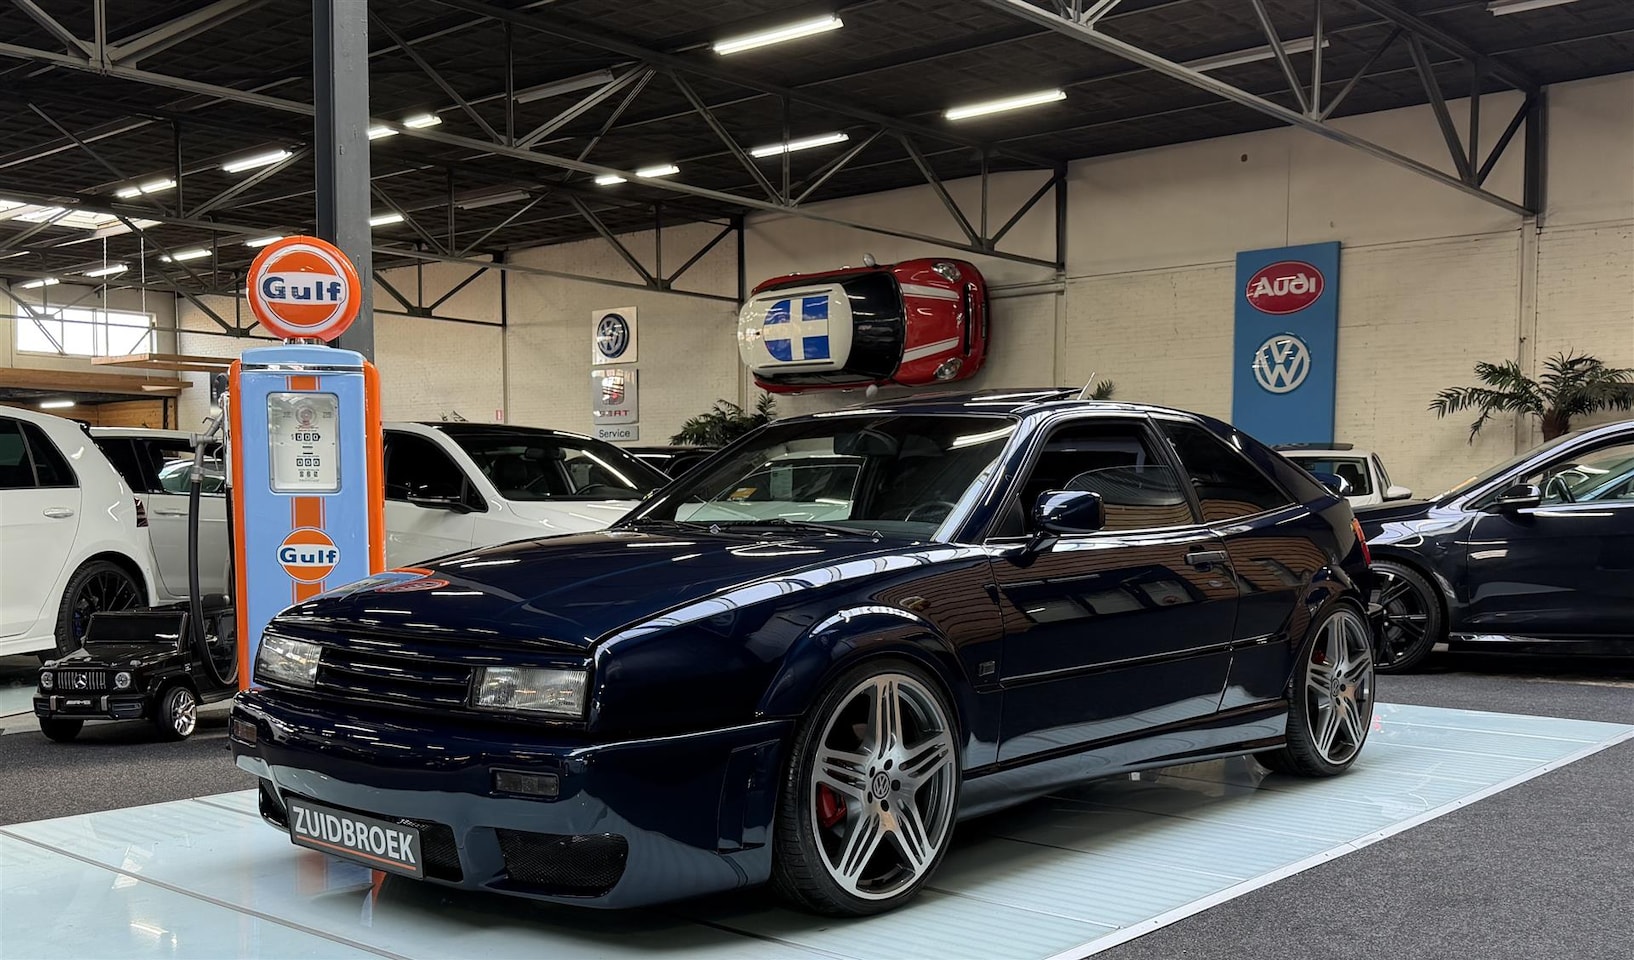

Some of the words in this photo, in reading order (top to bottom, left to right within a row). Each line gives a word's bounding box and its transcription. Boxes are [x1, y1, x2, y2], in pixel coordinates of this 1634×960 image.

[262, 277, 341, 300] Gulf
[599, 429, 630, 438] Service
[280, 548, 337, 564] Gulf
[292, 806, 416, 864] ZUIDBROEK
